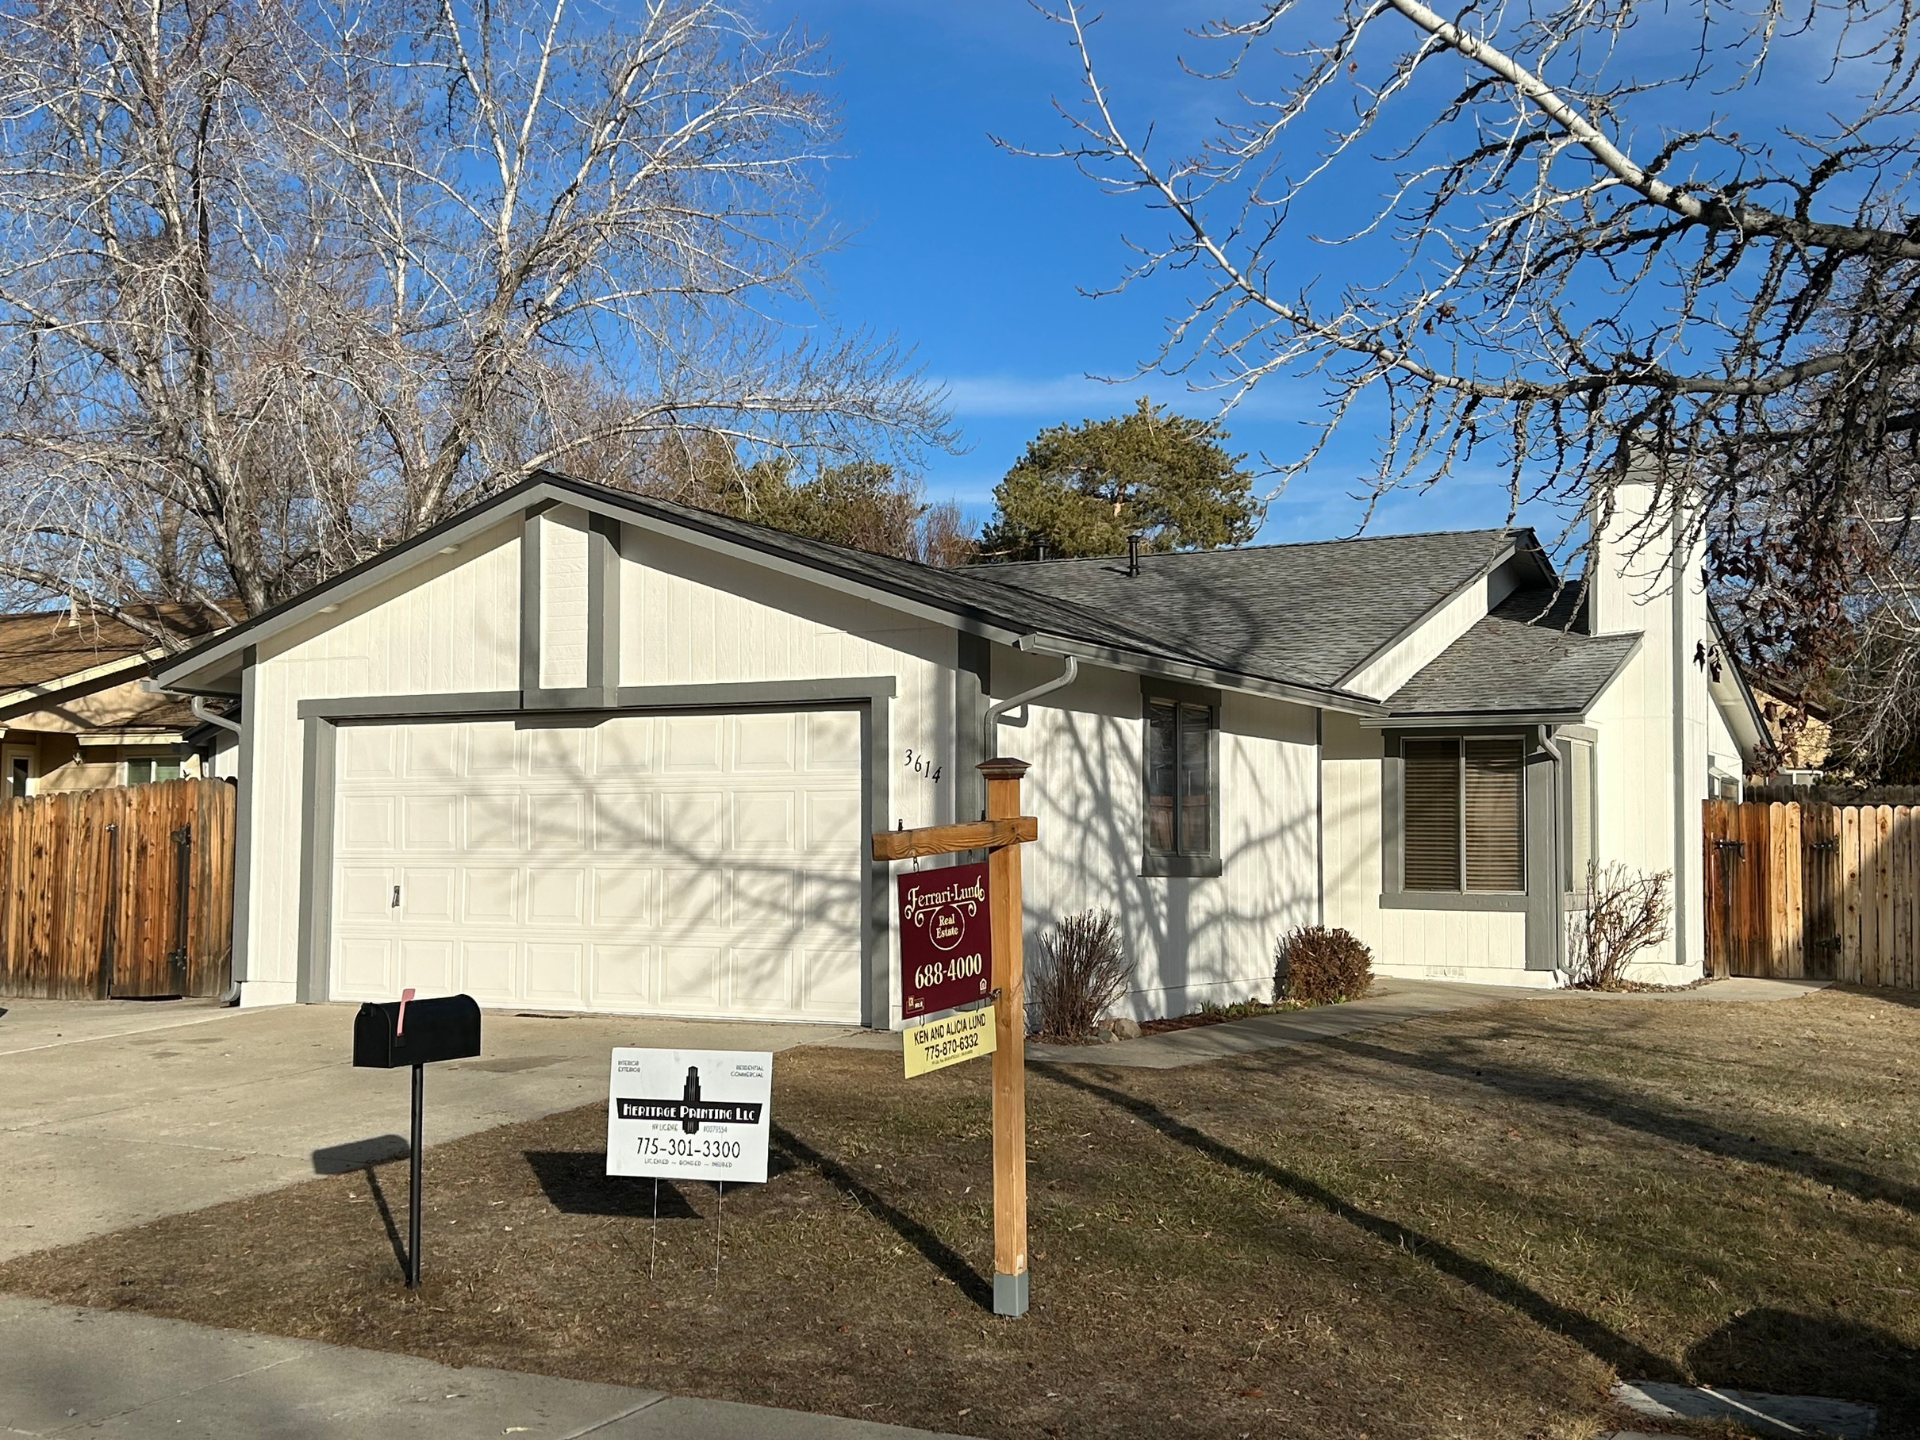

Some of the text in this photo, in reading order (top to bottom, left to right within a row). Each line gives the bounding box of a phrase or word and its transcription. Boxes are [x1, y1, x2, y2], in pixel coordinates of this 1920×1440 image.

[904, 749, 943, 784] 3614
[904, 875, 986, 920] Ferrari-Lund
[936, 926, 959, 939] Estate
[938, 913, 956, 927] Real
[915, 953, 982, 990] 688-4000
[914, 1013, 986, 1046] KEN AND ALICIA LUND
[924, 1032, 979, 1062] 775-870-6332
[735, 1064, 764, 1072] RESIDENTIAL
[623, 1103, 677, 1118] HERITAGE
[680, 1105, 733, 1120] PAINTING
[636, 1136, 741, 1159] 775-301-3300
